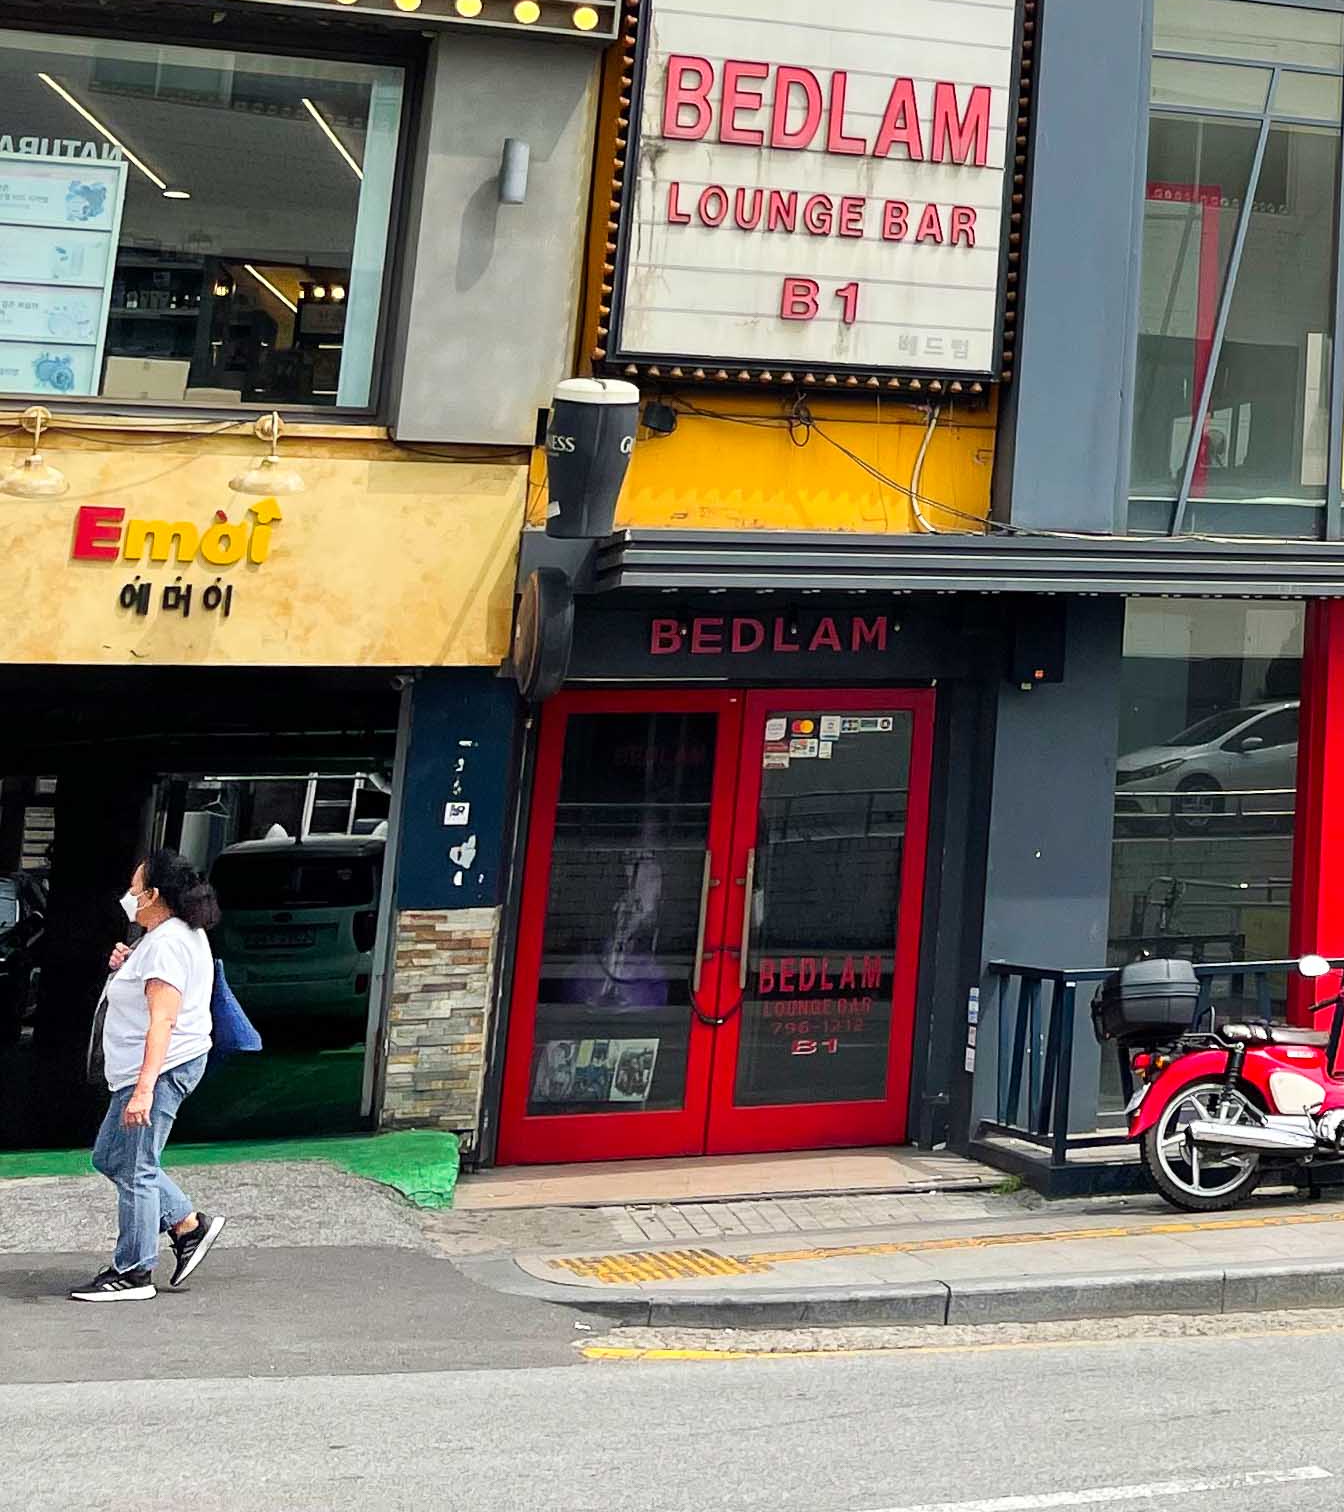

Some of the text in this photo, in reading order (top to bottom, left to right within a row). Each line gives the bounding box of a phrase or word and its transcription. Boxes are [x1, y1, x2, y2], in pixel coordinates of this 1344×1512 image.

[661, 53, 992, 168] BEDLAM
[667, 180, 977, 248] LOUNGE BAR
[780, 277, 860, 325] B1
[649, 615, 889, 656] BEDLAM
[759, 952, 882, 993] BEDLAM
